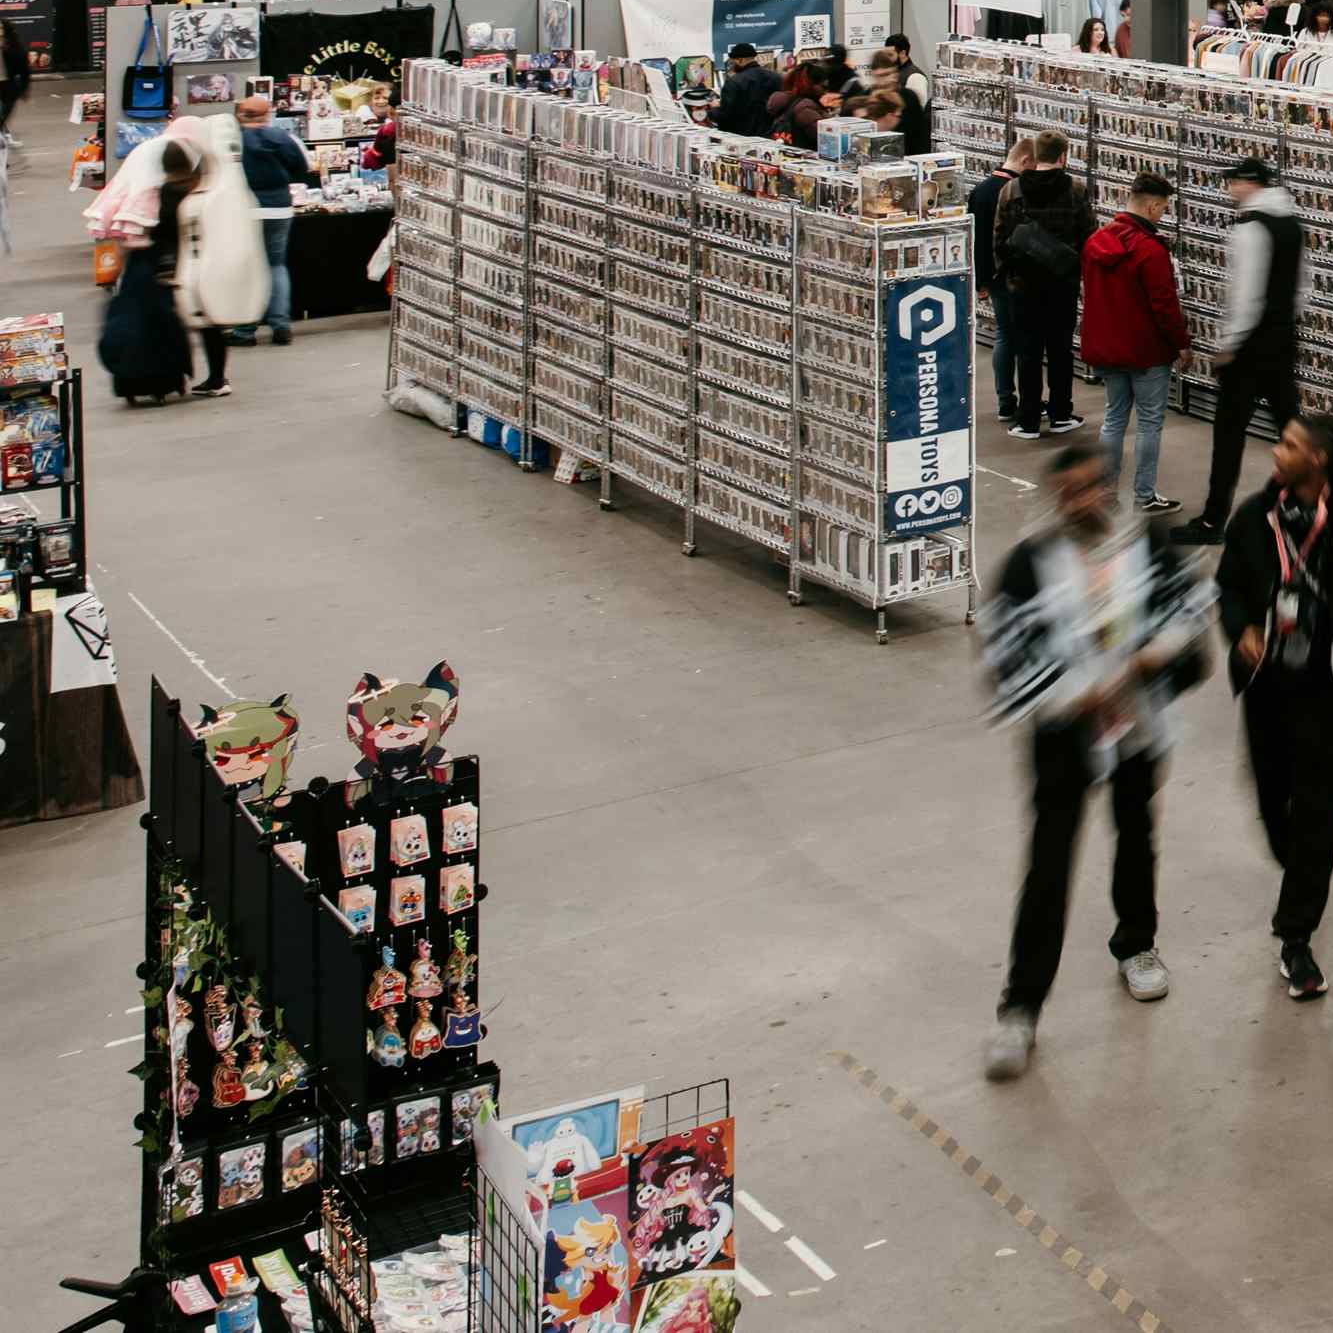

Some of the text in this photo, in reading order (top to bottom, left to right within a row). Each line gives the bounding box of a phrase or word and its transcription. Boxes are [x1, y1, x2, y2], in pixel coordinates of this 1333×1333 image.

[311, 40, 361, 65] Little
[363, 41, 395, 63] Box
[916, 349, 940, 484] PERSONA TOYS
